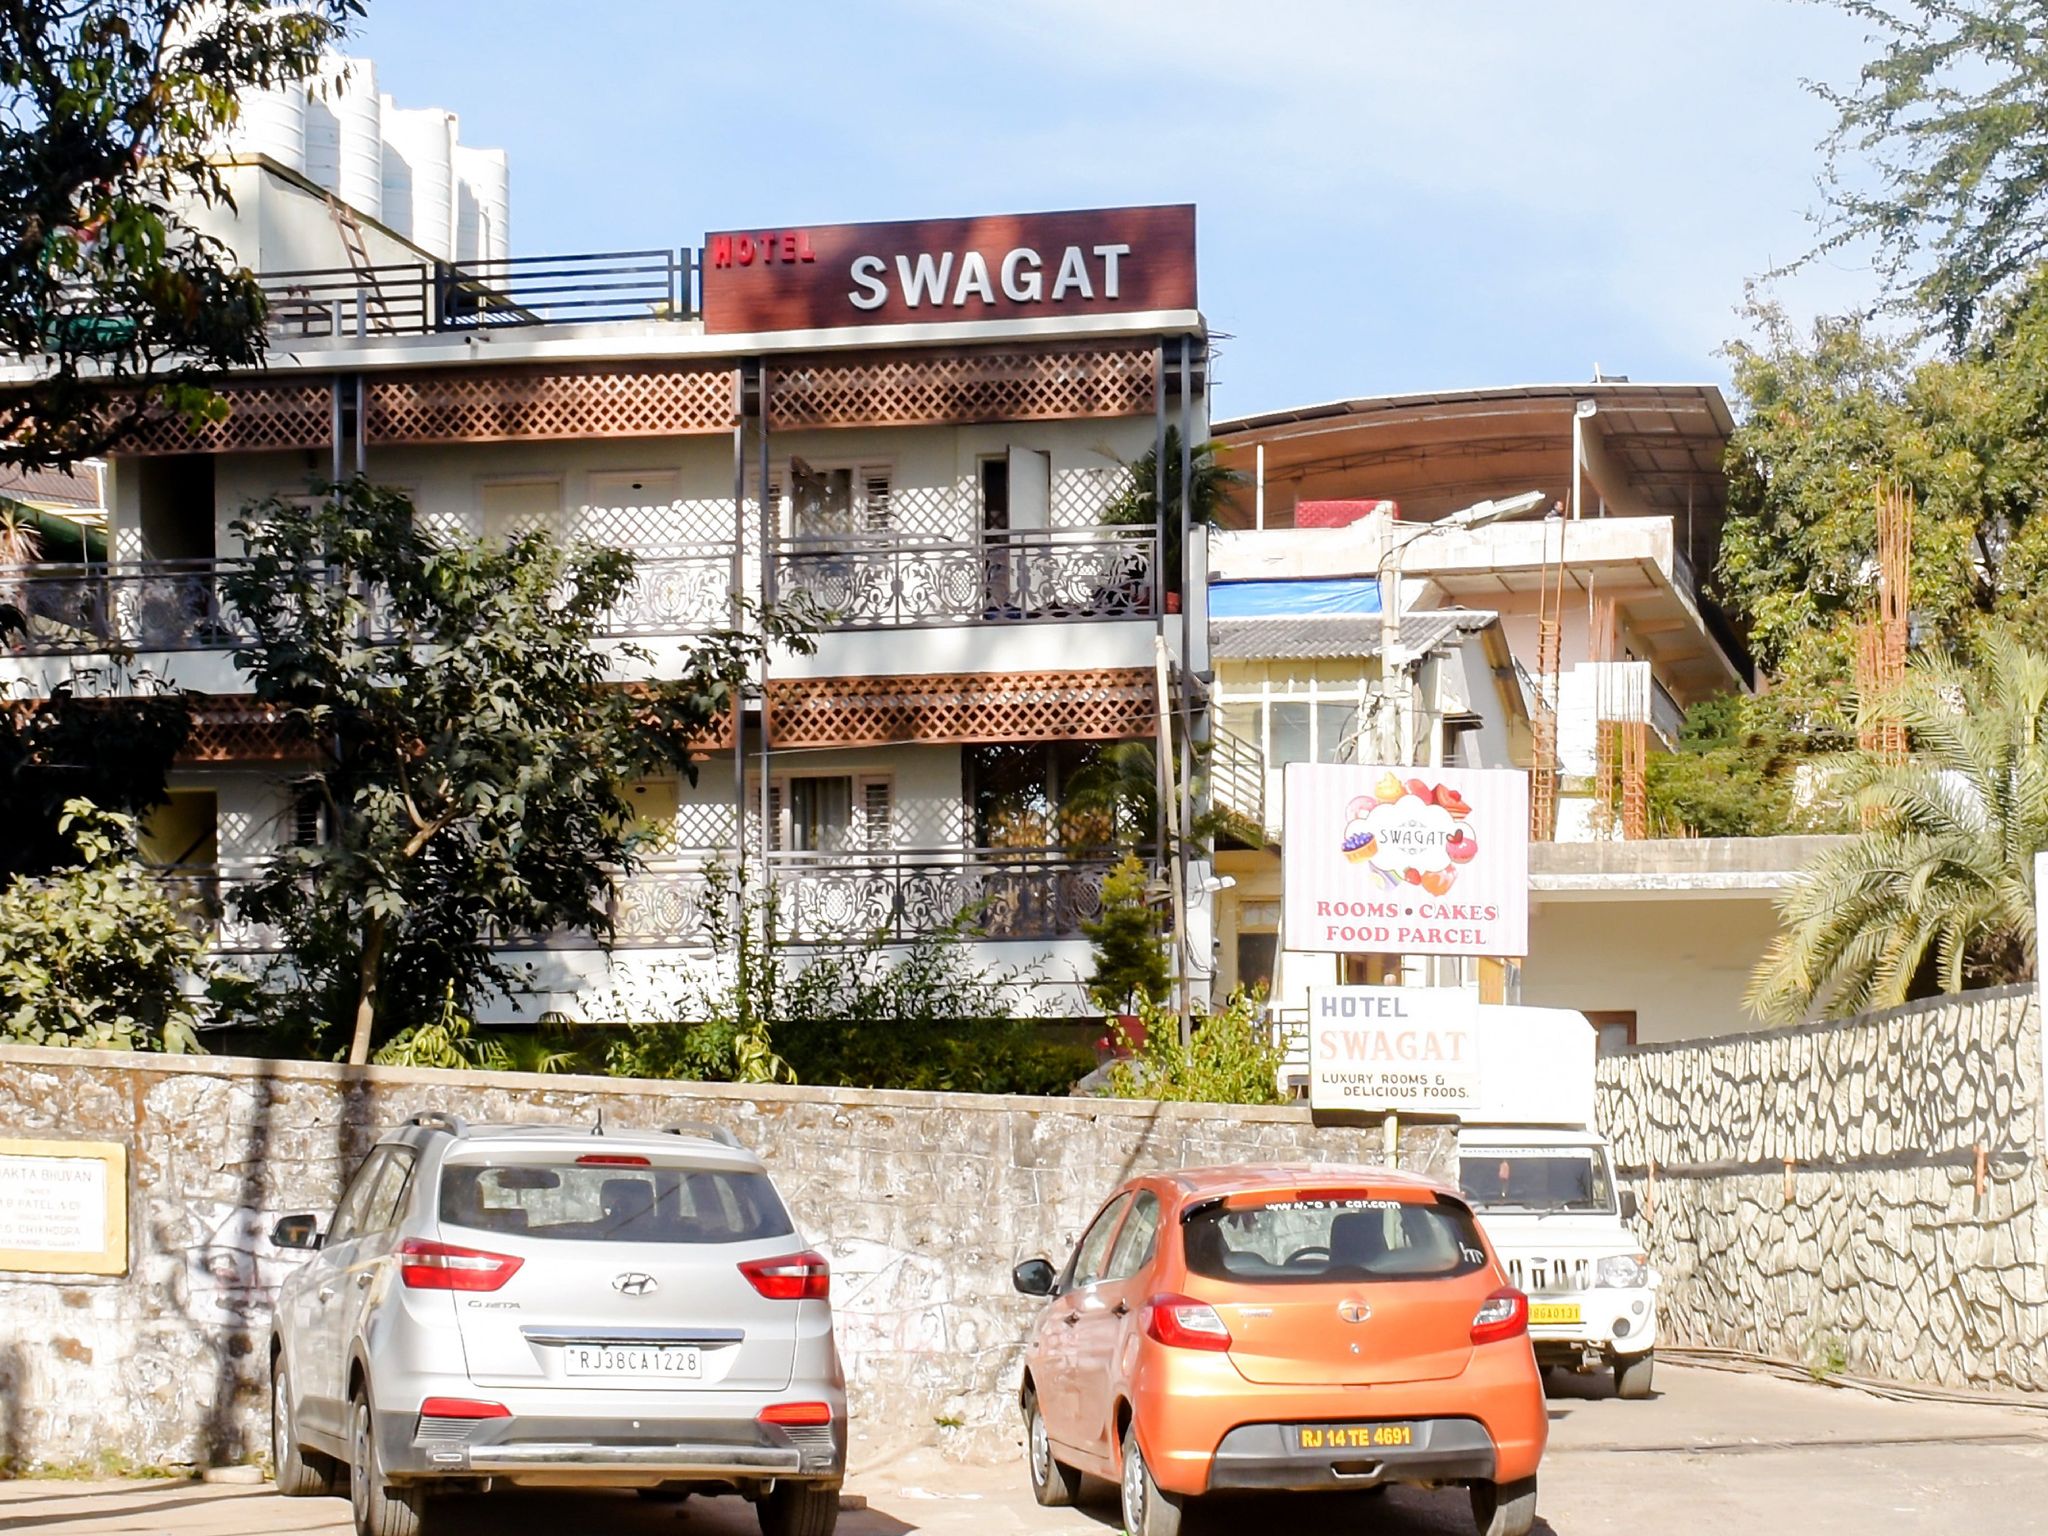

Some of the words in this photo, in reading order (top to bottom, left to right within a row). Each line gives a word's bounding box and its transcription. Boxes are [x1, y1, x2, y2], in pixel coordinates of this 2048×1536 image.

[712, 231, 816, 269] HOTEL
[848, 243, 1131, 310] SWAGAT
[1379, 828, 1446, 846] SWAGAT
[1316, 901, 1399, 918] ROOMS
[1418, 903, 1498, 921] CAKES
[1326, 925, 1390, 942] FOOD
[1398, 927, 1487, 945] PARCEL
[1321, 996, 1408, 1018] HOTEL
[1319, 1030, 1468, 1062] SWAGAT
[1322, 1073, 1374, 1084] LUXURY
[1381, 1074, 1428, 1085] ROOMS
[1435, 1075, 1445, 1086] &
[1343, 1086, 1418, 1097] DELICIOUS
[1423, 1087, 1470, 1098] FOODS.
[40, 1168, 92, 1183] BHUVAN
[580, 1351, 697, 1371] RJ38CA1228
[1302, 1429, 1322, 1448] RJ
[1327, 1429, 1346, 1447] 14
[1348, 1428, 1370, 1447] TE
[1374, 1427, 1410, 1446] 4691
